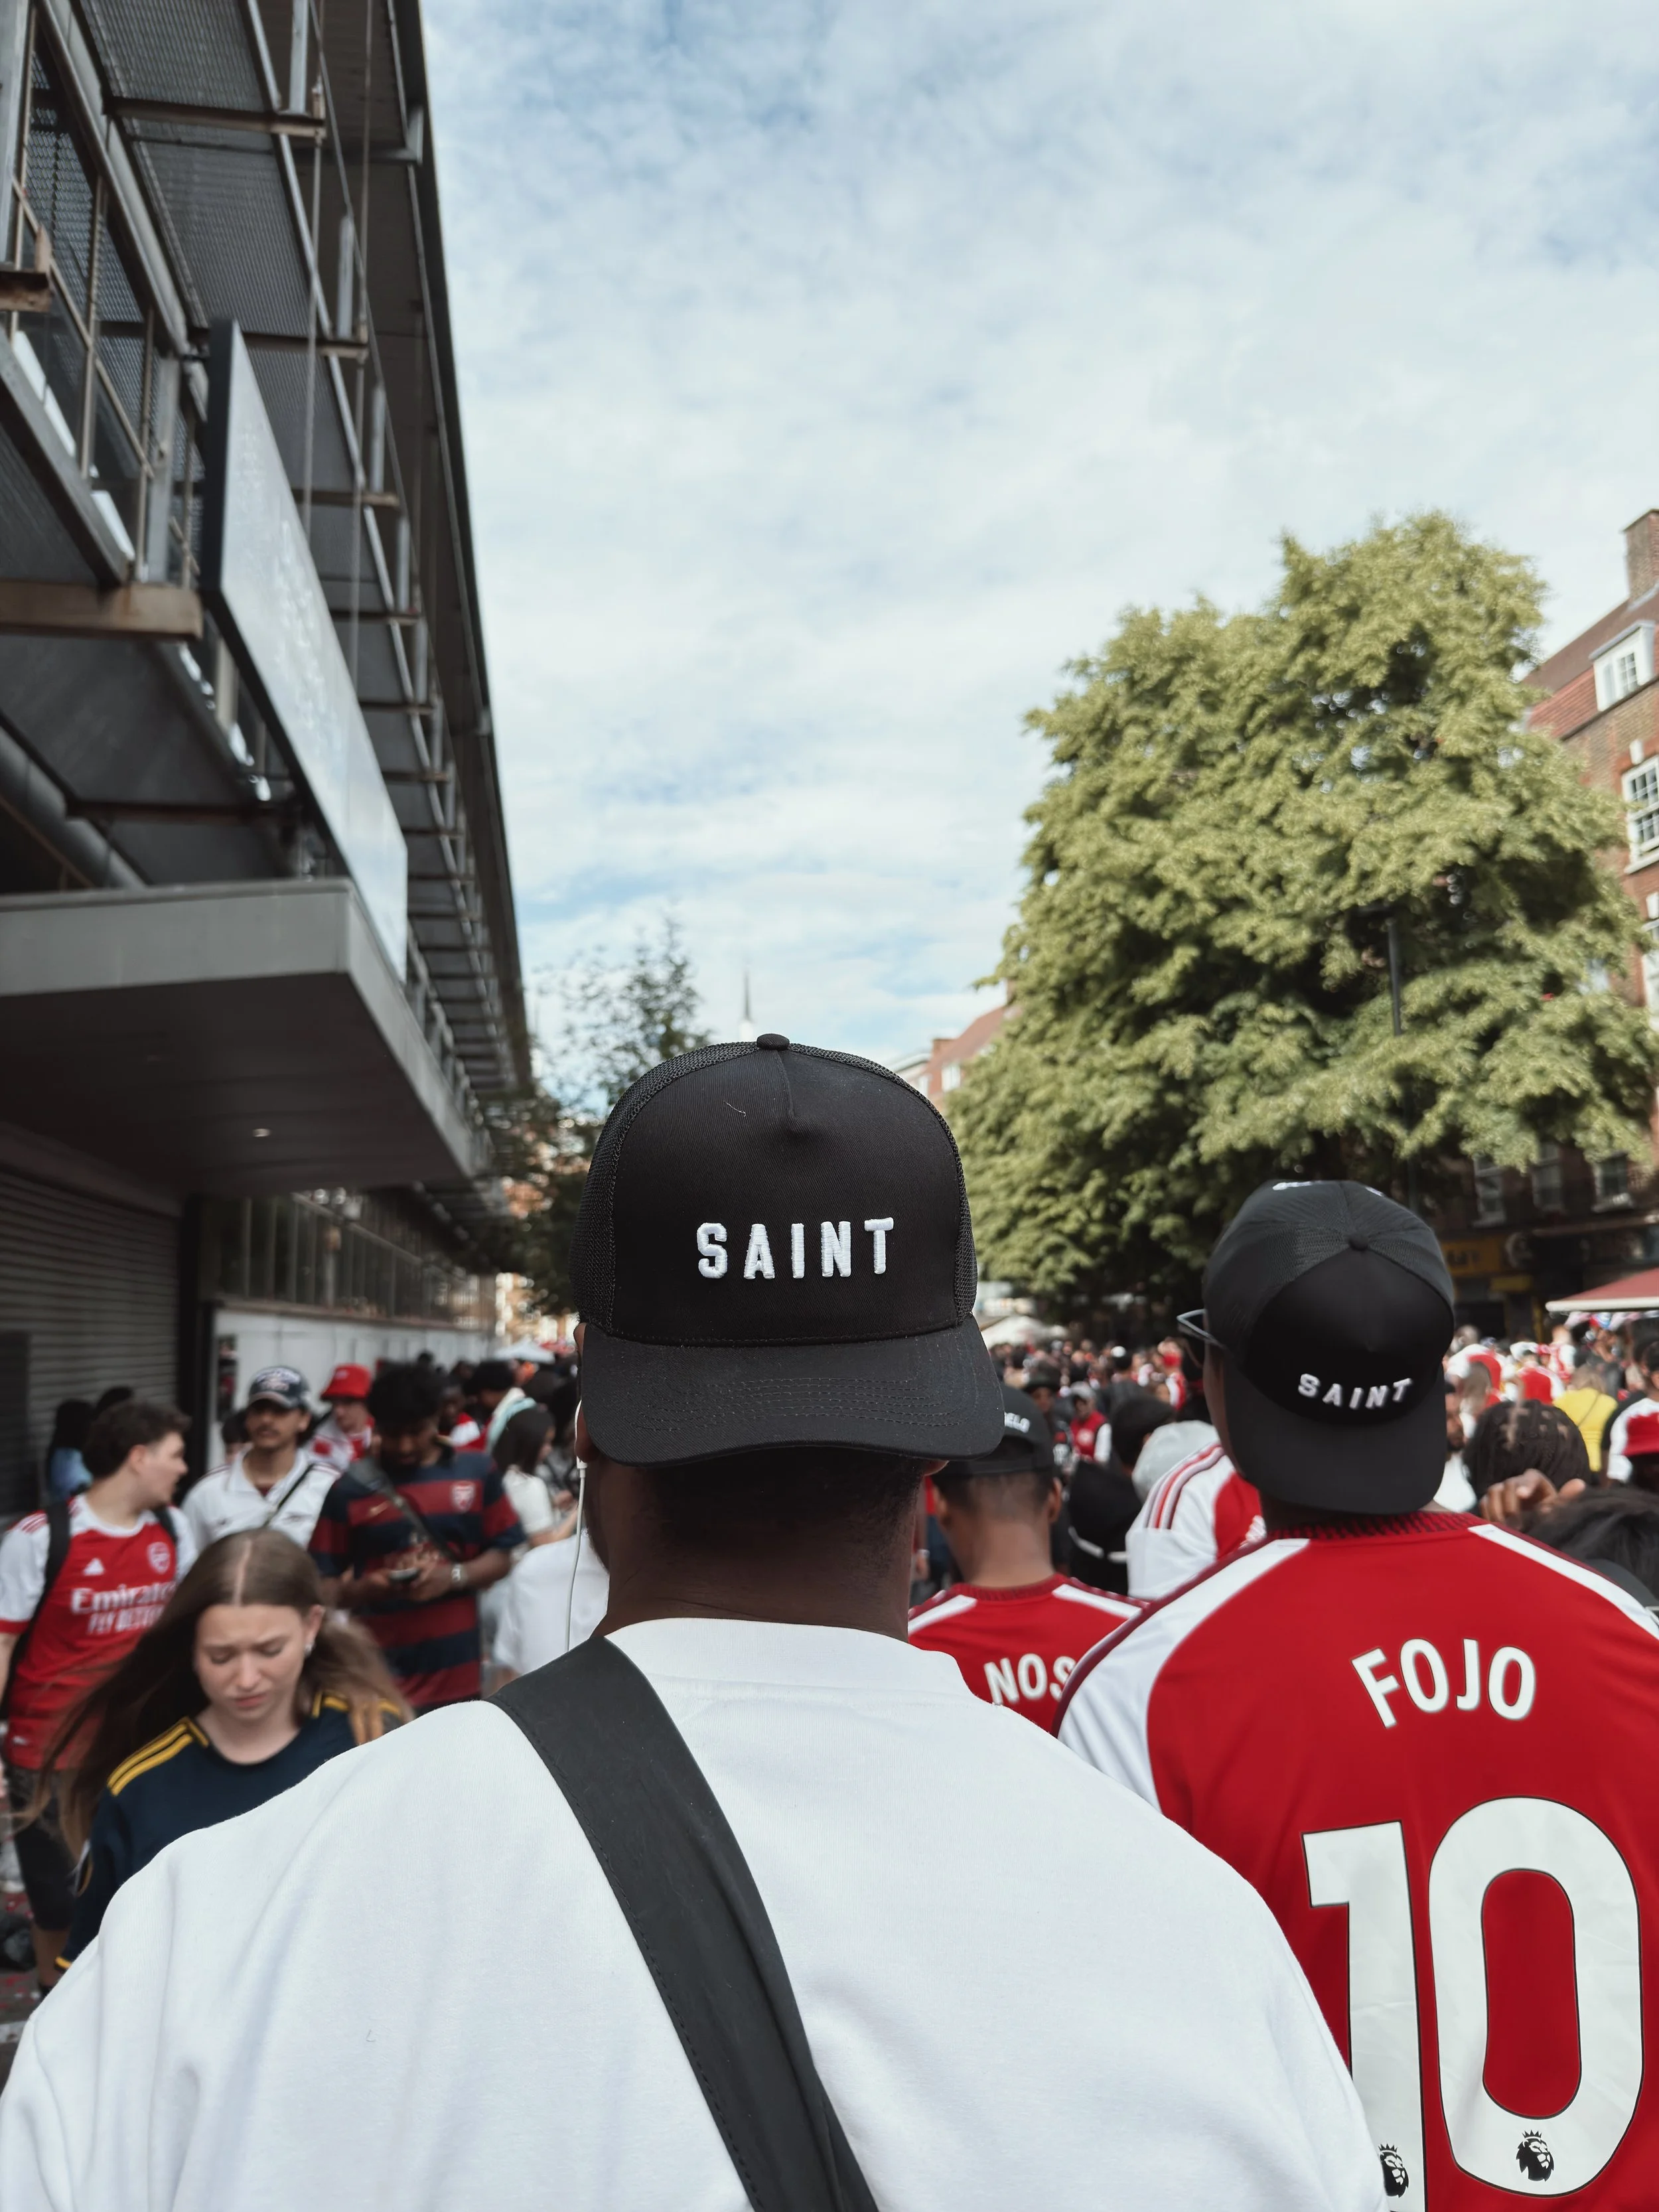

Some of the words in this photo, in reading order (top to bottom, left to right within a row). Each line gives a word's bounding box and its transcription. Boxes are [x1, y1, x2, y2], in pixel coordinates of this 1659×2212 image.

[697, 1217, 894, 1279] SAINT
[1298, 1373, 1411, 1409] SAINT
[1350, 1637, 1536, 1728] FOJO
[1301, 1795, 1644, 2212] 10
